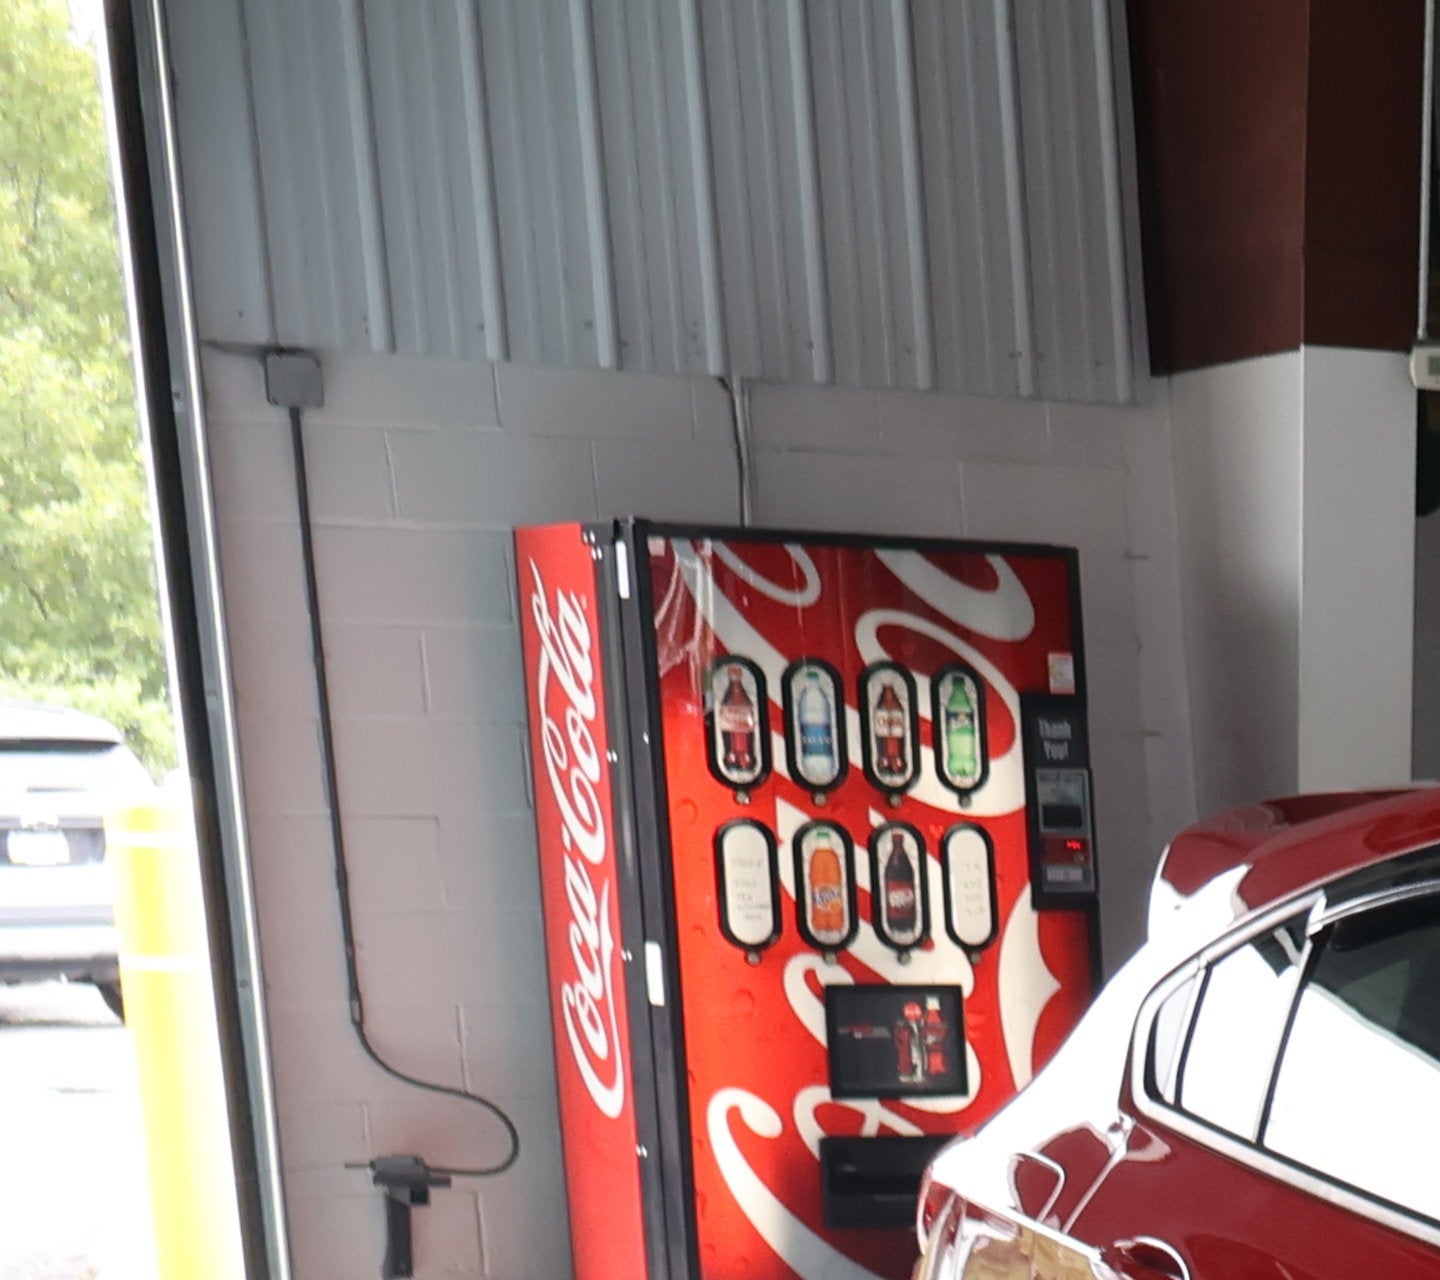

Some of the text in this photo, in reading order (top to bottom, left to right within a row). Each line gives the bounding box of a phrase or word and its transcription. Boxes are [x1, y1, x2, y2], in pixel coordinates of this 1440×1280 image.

[1038, 717, 1072, 740] Thank
[1042, 739, 1069, 761] You!
[529, 556, 625, 1119] Coca-Cola
